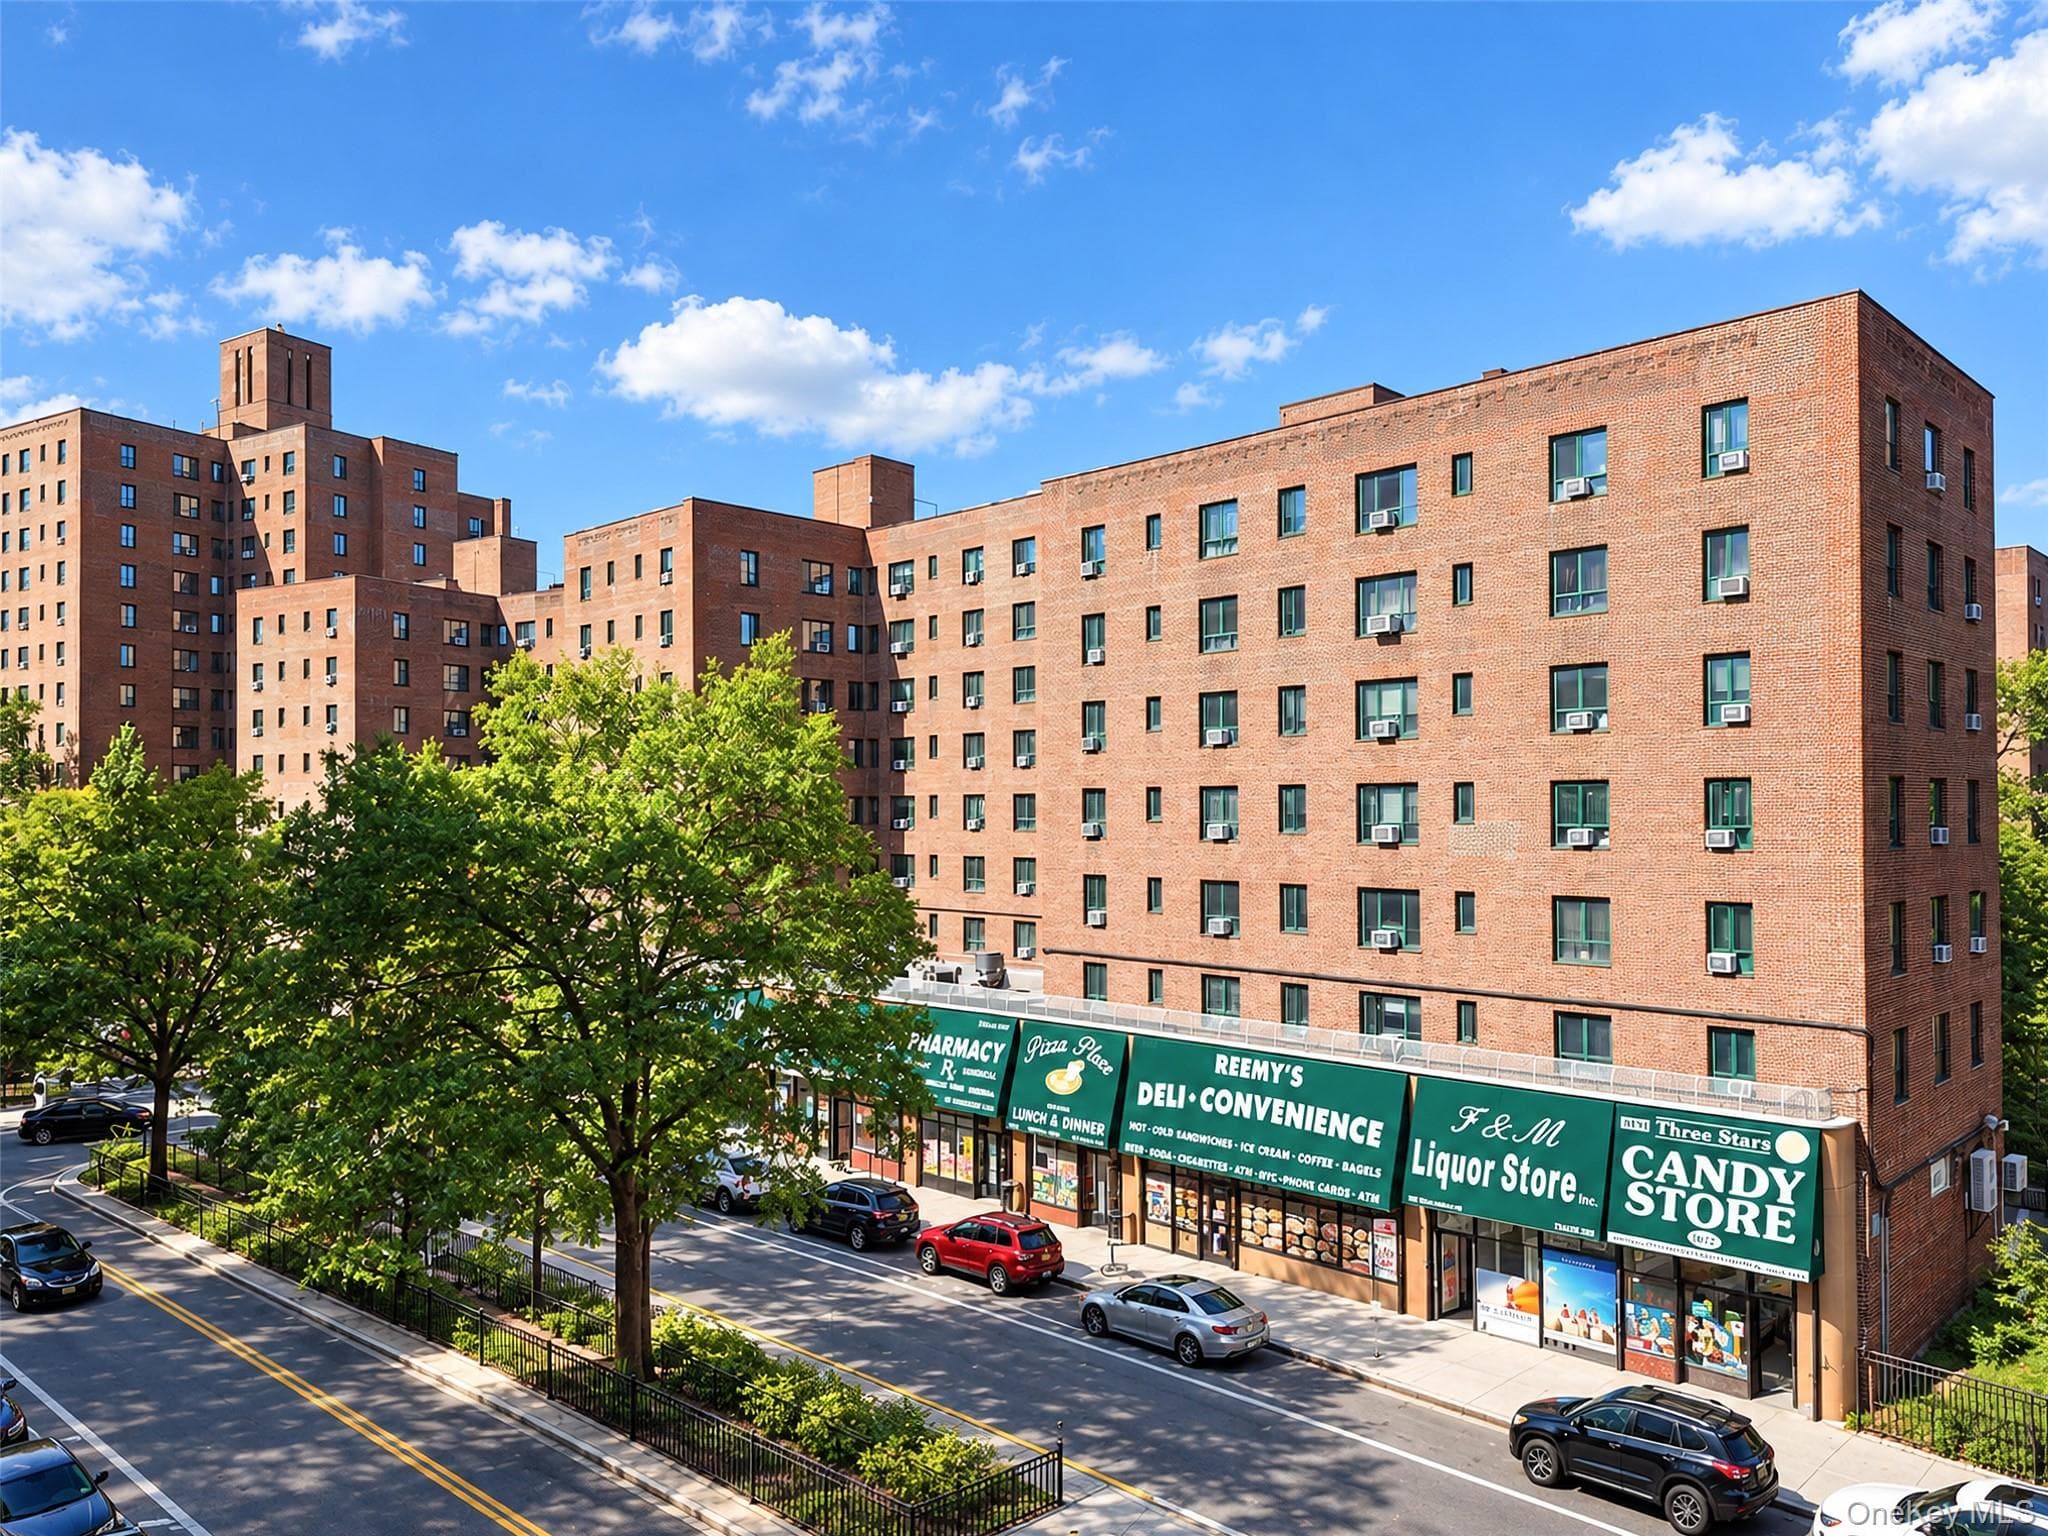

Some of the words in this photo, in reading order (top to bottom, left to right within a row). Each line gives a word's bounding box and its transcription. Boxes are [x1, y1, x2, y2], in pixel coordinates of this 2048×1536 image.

[907, 1032, 1006, 1064] PHARMACY
[1024, 1035, 1068, 1063] Pizza
[1214, 1053, 1304, 1088] REEMY'S
[1012, 1107, 1048, 1125] LUNCH
[1062, 1116, 1105, 1137] DINNER
[1137, 1081, 1186, 1109] DELI
[1199, 1086, 1385, 1149] CONVENIENCE
[1450, 1105, 1490, 1133] F
[1481, 1113, 1513, 1140] &
[1511, 1117, 1567, 1148] M
[1655, 1119, 1712, 1143] Three
[1718, 1129, 1771, 1152] Stars
[1411, 1138, 1496, 1190] Liquor
[1500, 1152, 1577, 1203] Store
[1578, 1193, 1599, 1207] Inc.
[1621, 1144, 1806, 1205] CANDY
[1624, 1181, 1796, 1245] STORE
